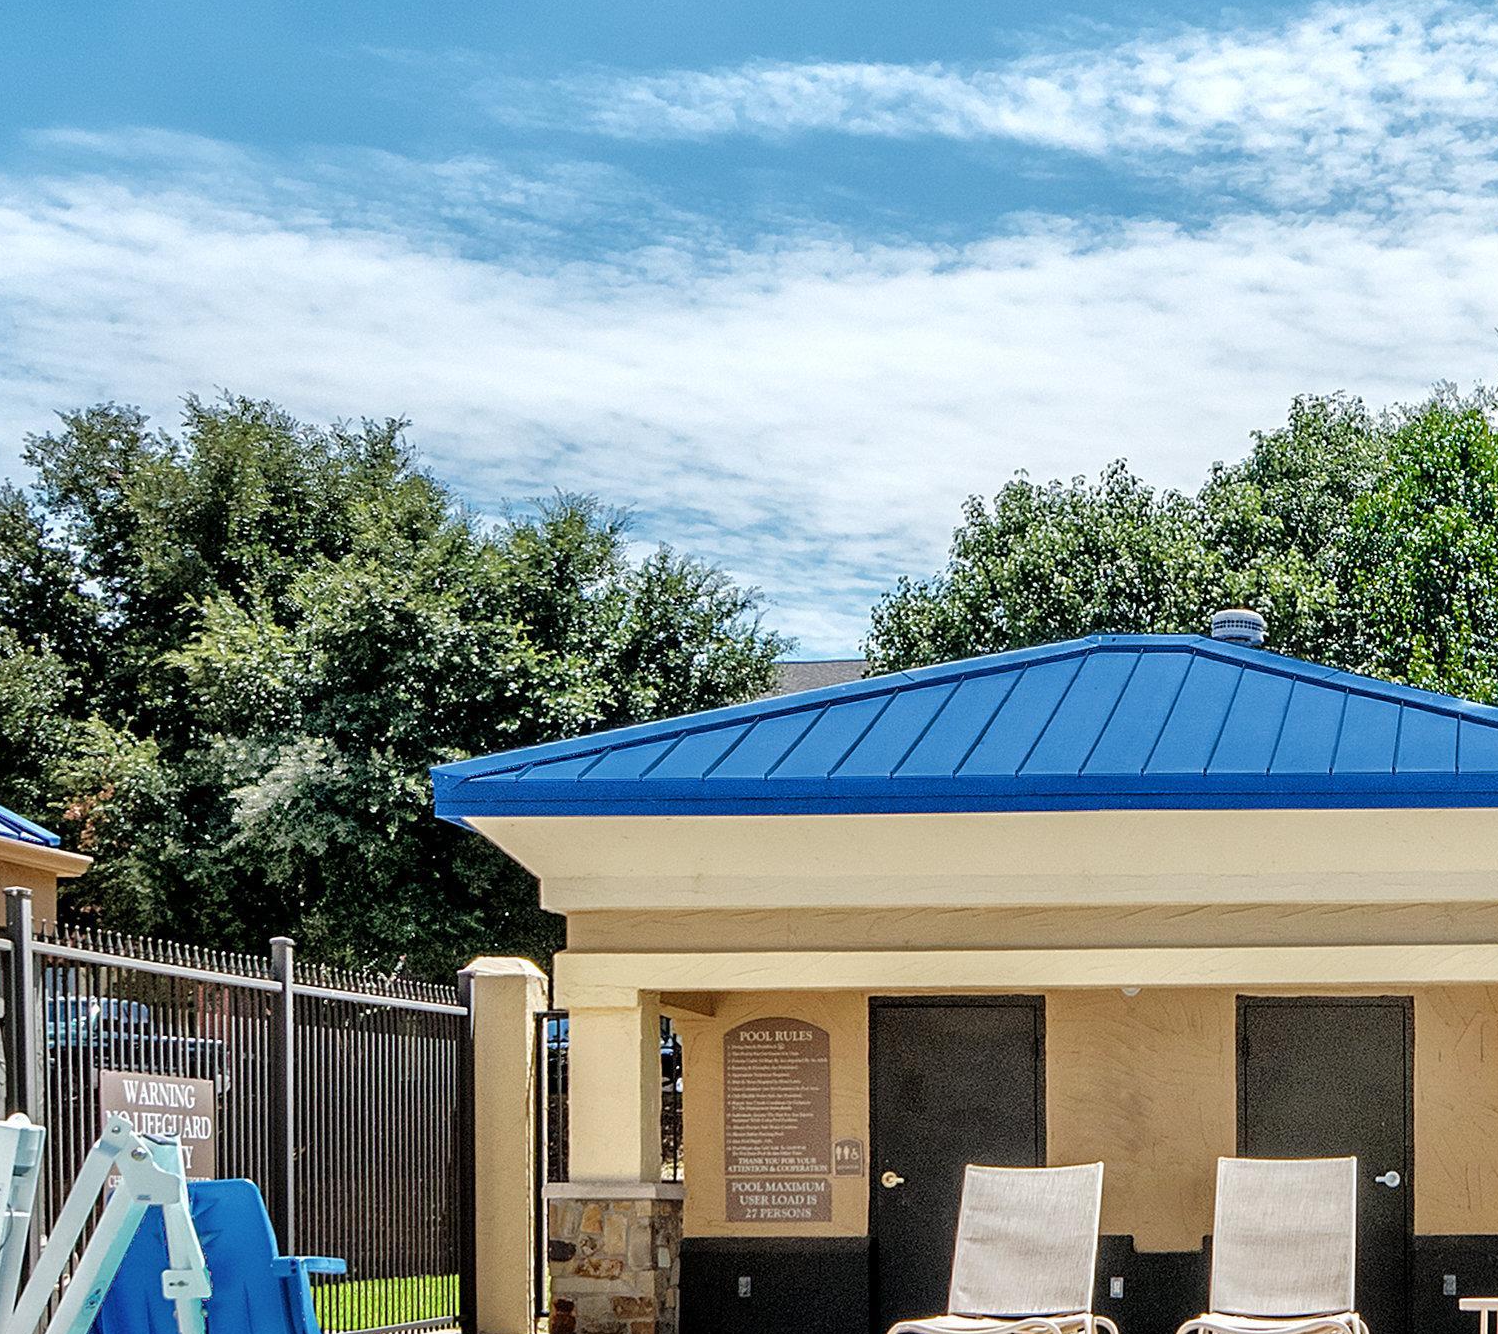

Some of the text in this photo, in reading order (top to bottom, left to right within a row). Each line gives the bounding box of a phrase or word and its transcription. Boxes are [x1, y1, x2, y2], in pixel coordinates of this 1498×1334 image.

[740, 1030, 813, 1041] POOL RULES
[122, 1079, 196, 1109] WARNING
[132, 1111, 212, 1140] LIFEGUARD
[728, 1165, 768, 1173] ATTENTION
[732, 1182, 825, 1192] POOL MAXIMUM
[739, 1195, 818, 1205] USER LOAD IS
[745, 1208, 812, 1219] 27 PERSONS
